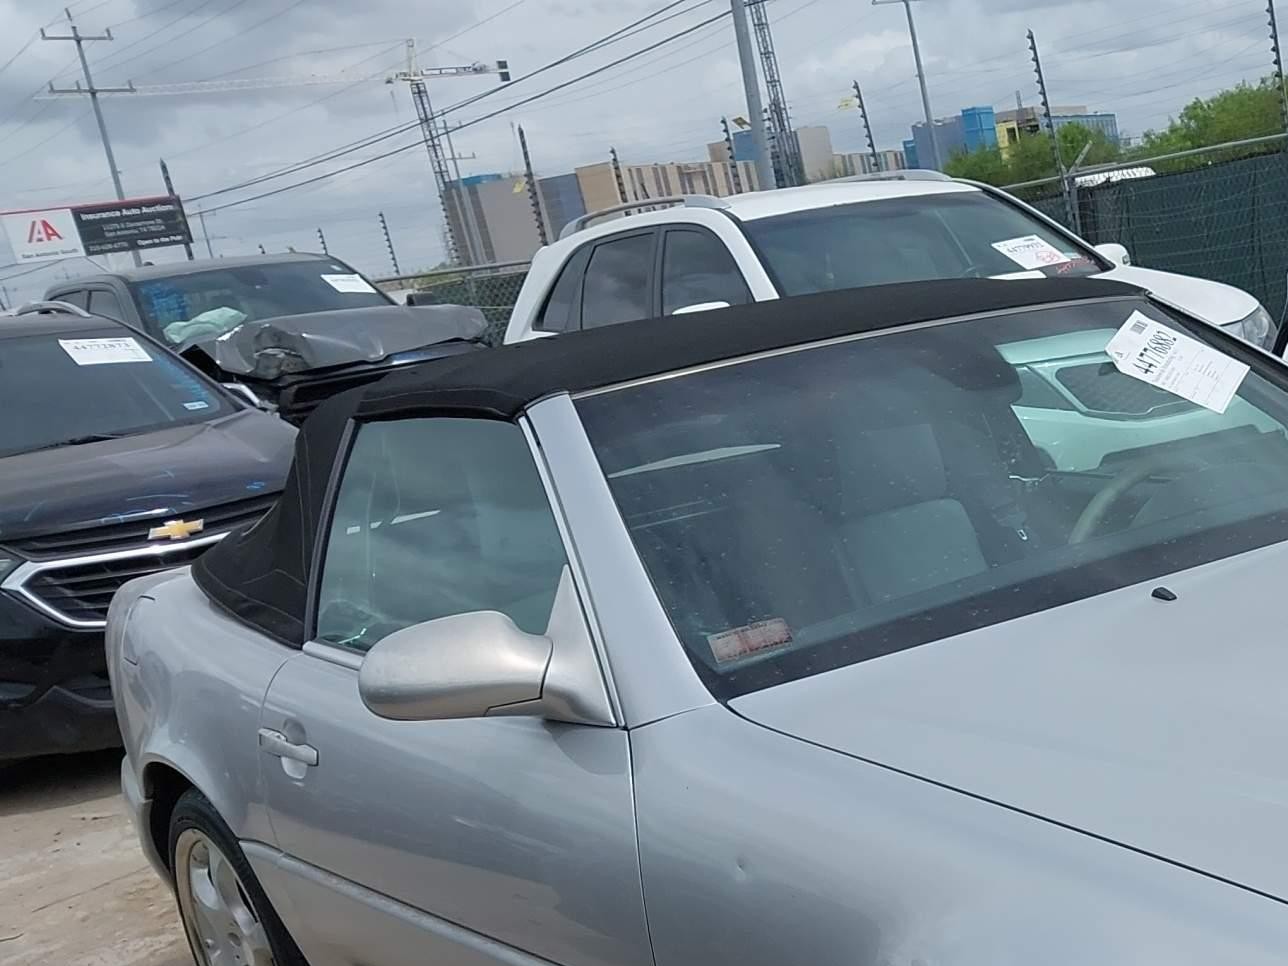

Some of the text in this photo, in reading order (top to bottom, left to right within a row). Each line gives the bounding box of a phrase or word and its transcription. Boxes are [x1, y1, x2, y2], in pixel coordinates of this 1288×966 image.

[80, 210, 121, 221] Insurance
[121, 208, 141, 216] Auto
[1132, 329, 1177, 375] 44776882
